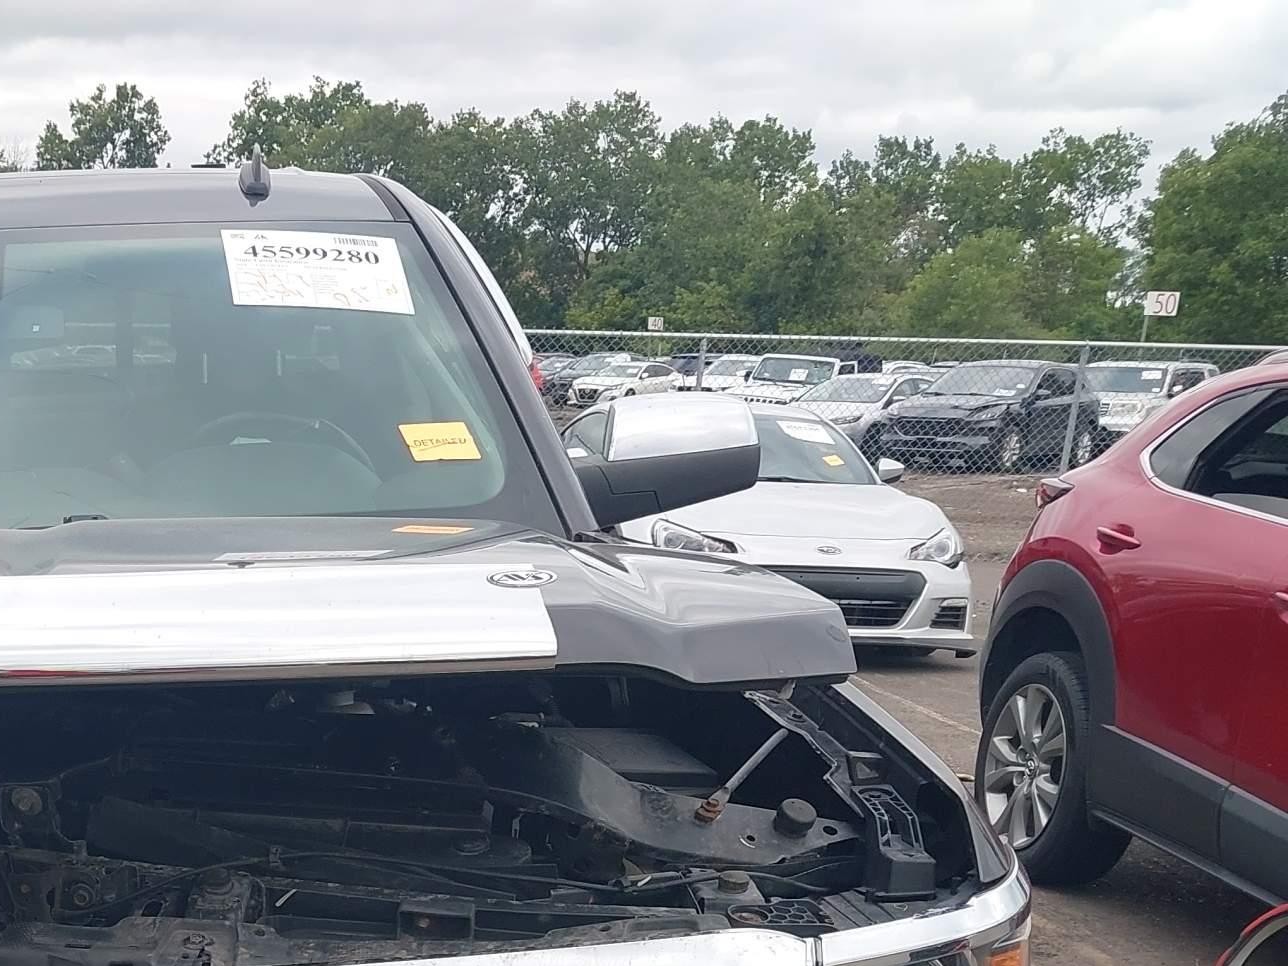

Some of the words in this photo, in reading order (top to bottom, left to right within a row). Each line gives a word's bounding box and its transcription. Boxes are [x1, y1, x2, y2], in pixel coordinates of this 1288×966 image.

[243, 244, 380, 265] 45599280
[1152, 293, 1177, 314] 50
[651, 318, 663, 330] 40
